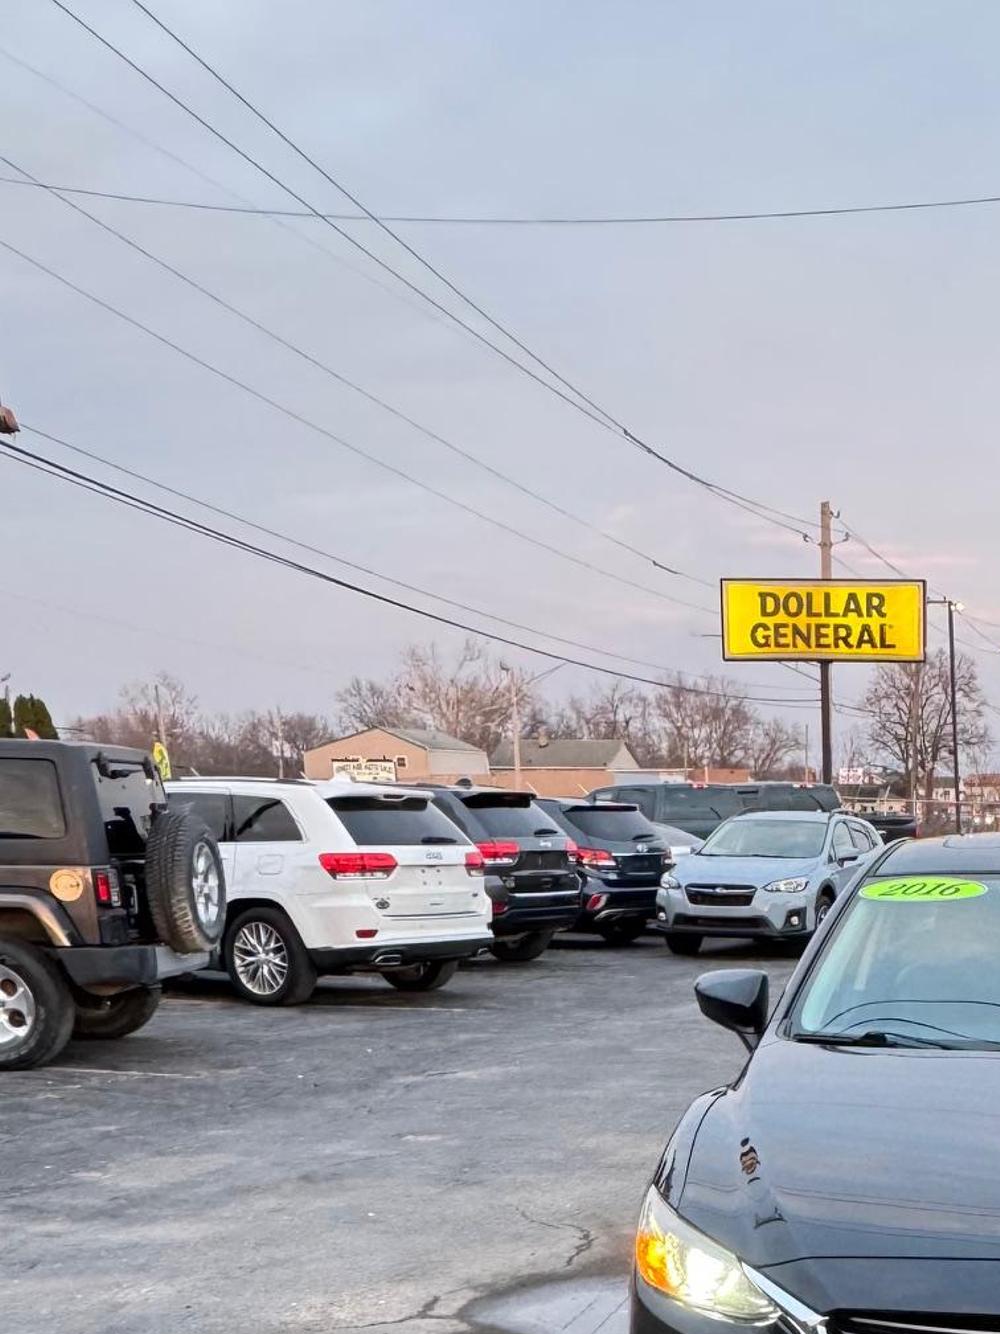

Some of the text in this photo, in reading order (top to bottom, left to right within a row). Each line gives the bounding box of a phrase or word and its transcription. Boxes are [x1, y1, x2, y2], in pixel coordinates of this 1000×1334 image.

[758, 592, 887, 618] DOLLAR
[750, 623, 896, 649] GENERAL
[878, 882, 967, 897] 2016
